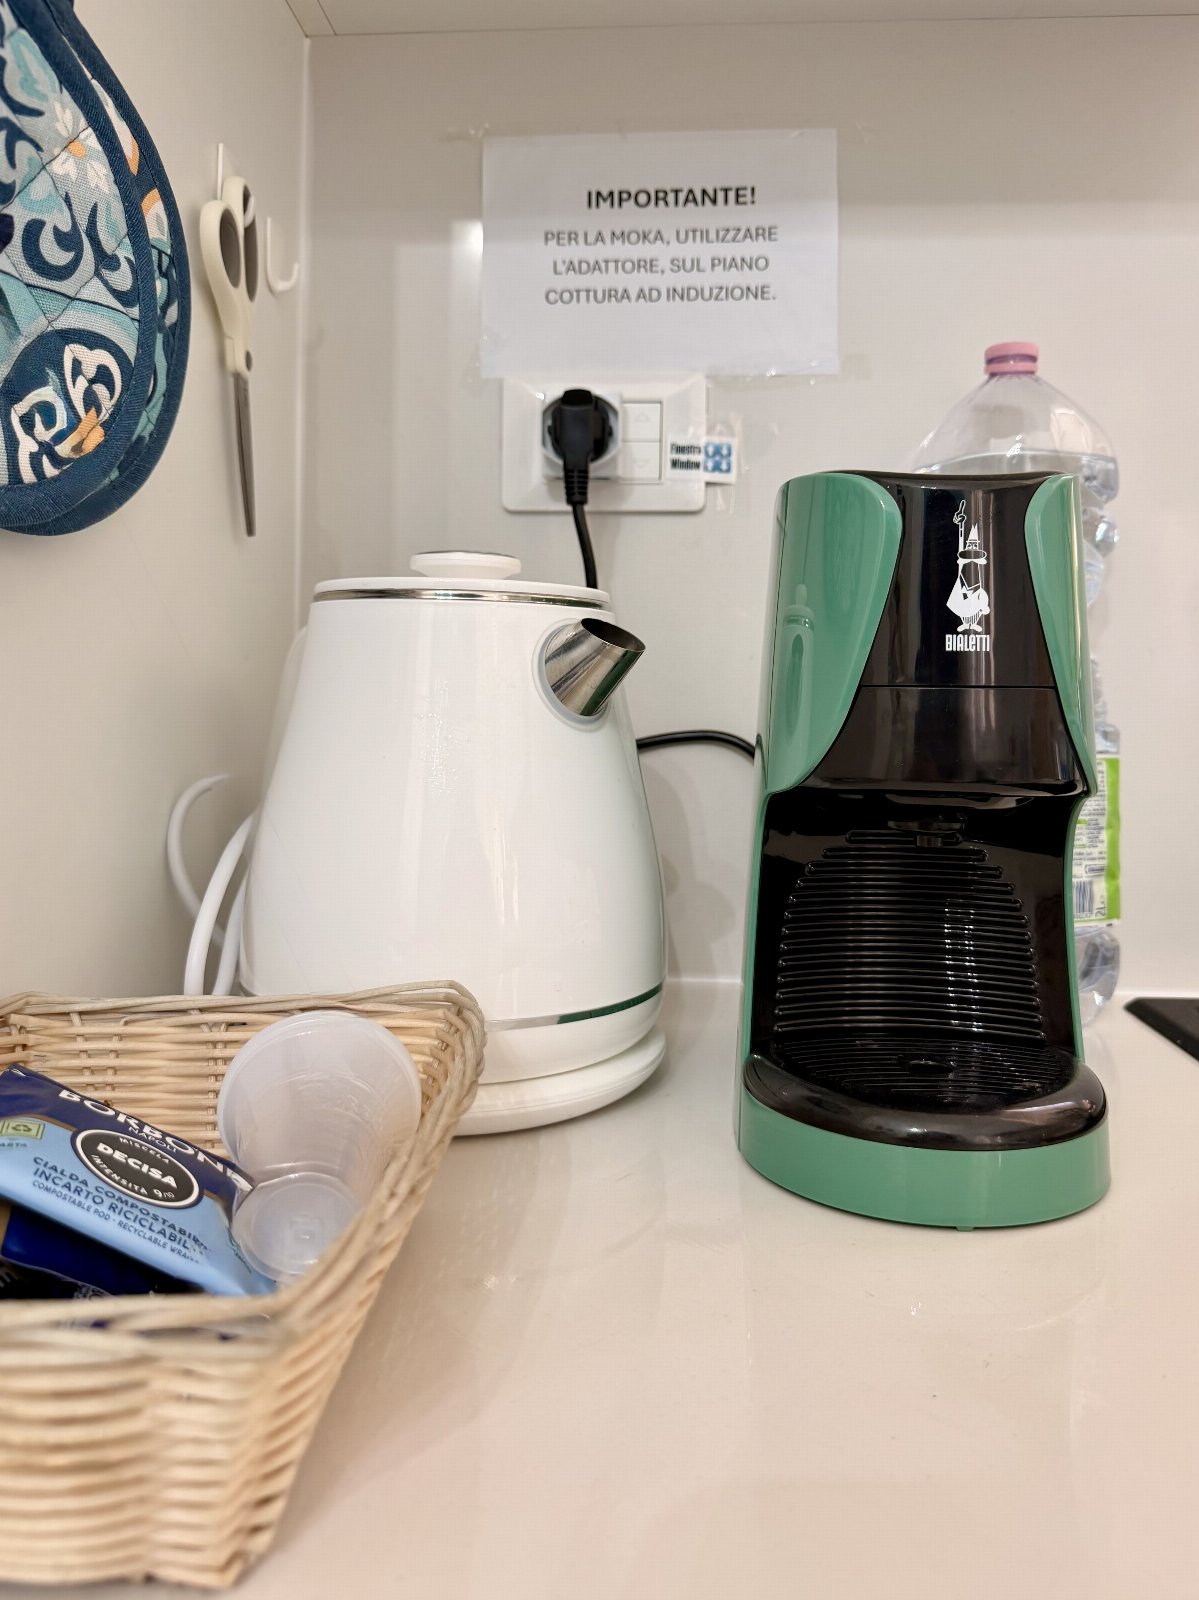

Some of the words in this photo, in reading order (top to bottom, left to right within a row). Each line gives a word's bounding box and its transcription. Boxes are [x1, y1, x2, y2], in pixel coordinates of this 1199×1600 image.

[586, 186, 757, 210] IMPORTANTE!
[544, 231, 579, 247] PER
[584, 231, 606, 246] LA
[611, 229, 671, 247] MOKA,
[676, 226, 779, 245] UTILIZZARE
[553, 258, 665, 276] L'ADATTORE,
[670, 257, 706, 274] SUL
[711, 255, 770, 272] PIANO
[545, 287, 632, 305] COTTURA
[635, 287, 661, 303] AD
[666, 285, 777, 303] INDUZIONE.
[670, 444, 702, 455] Finestra
[671, 459, 701, 470] Window
[945, 634, 990, 652] BIALETTI
[119, 1137, 170, 1164] MISCELA
[128, 1126, 177, 1153] NAPOLI
[33, 1156, 89, 1188] CIALDA
[96, 1142, 178, 1189] DECISA
[33, 1167, 104, 1205] INCARTO
[32, 1179, 93, 1213] COMPOSTABLE
[93, 1208, 111, 1221] POD
[117, 1219, 169, 1250] RECYCLABLE
